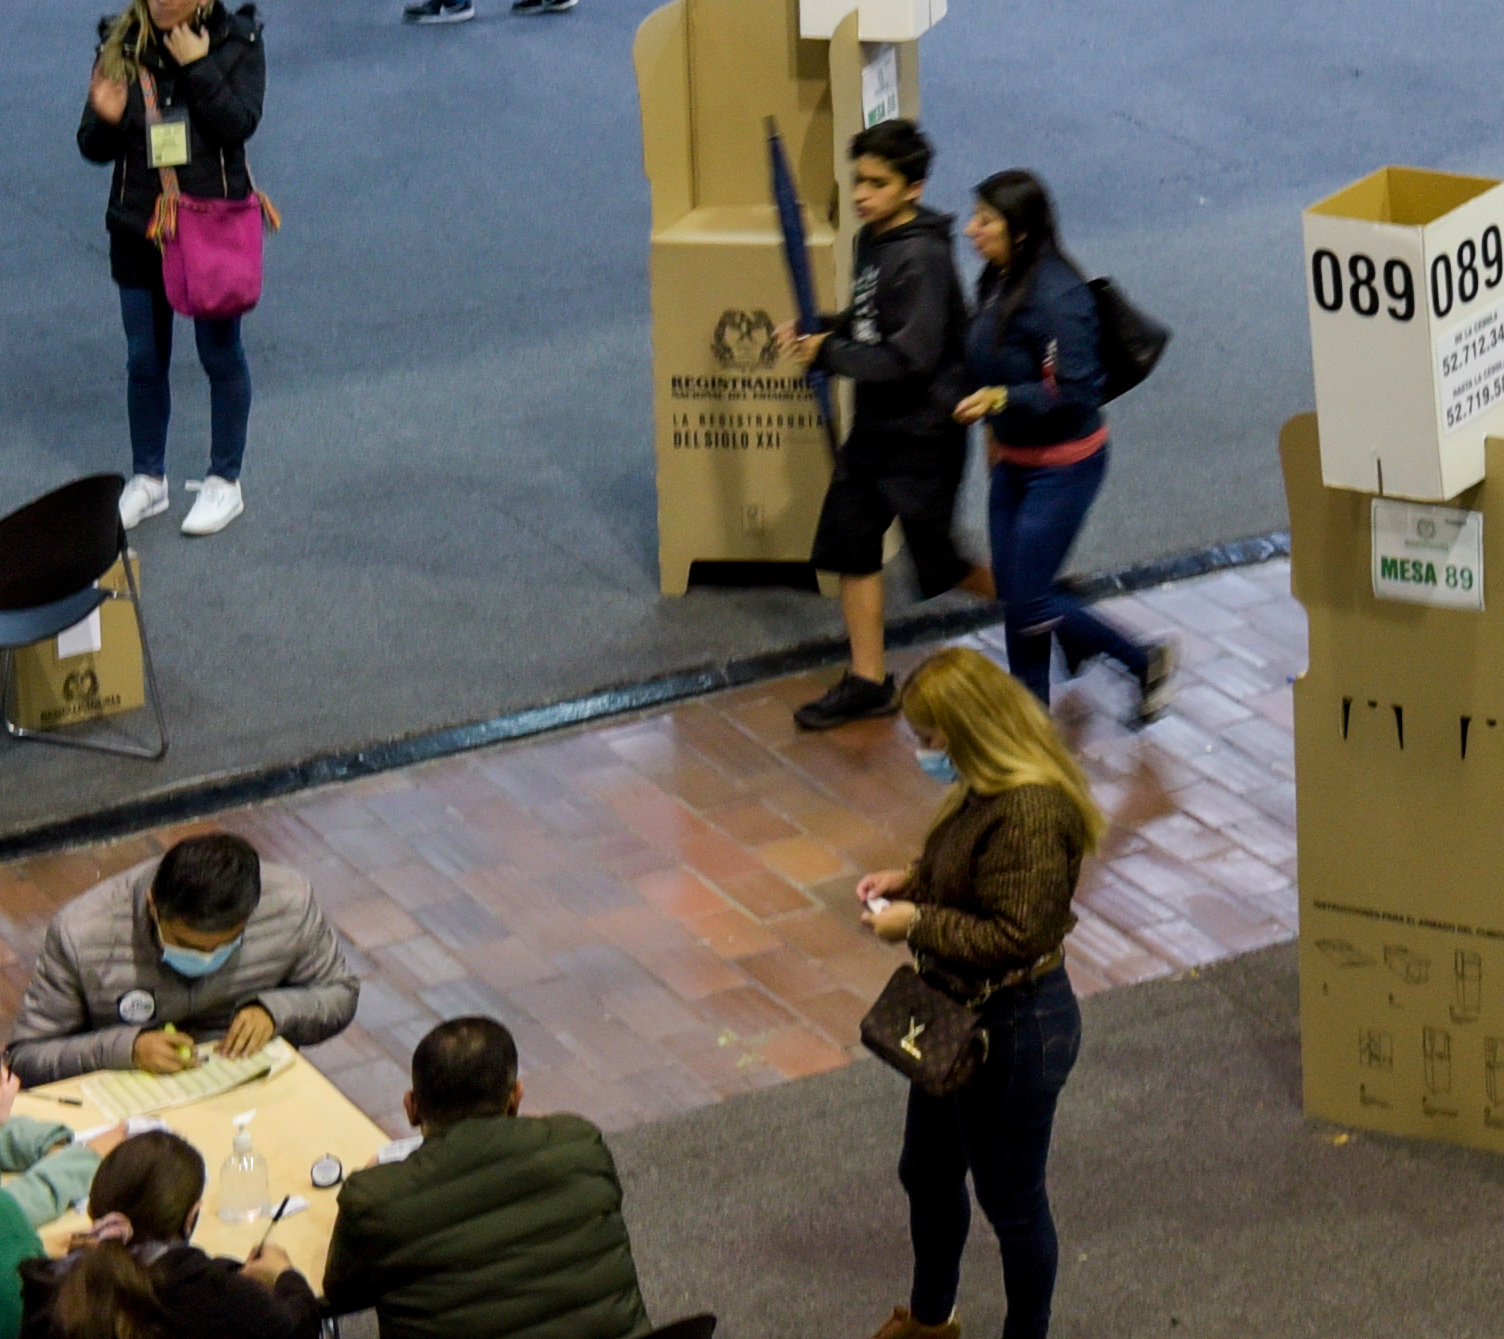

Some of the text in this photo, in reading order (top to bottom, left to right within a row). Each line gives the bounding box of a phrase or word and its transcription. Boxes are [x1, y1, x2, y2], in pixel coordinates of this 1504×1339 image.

[1430, 224, 1504, 319] 089
[1312, 249, 1416, 323] 089
[671, 375, 815, 391] REGISTRADURÍ
[673, 413, 825, 429] LA REGISTRADURÍA
[673, 432, 782, 451] DEL SIGLO XXI
[1380, 555, 1474, 591] MESA 89
